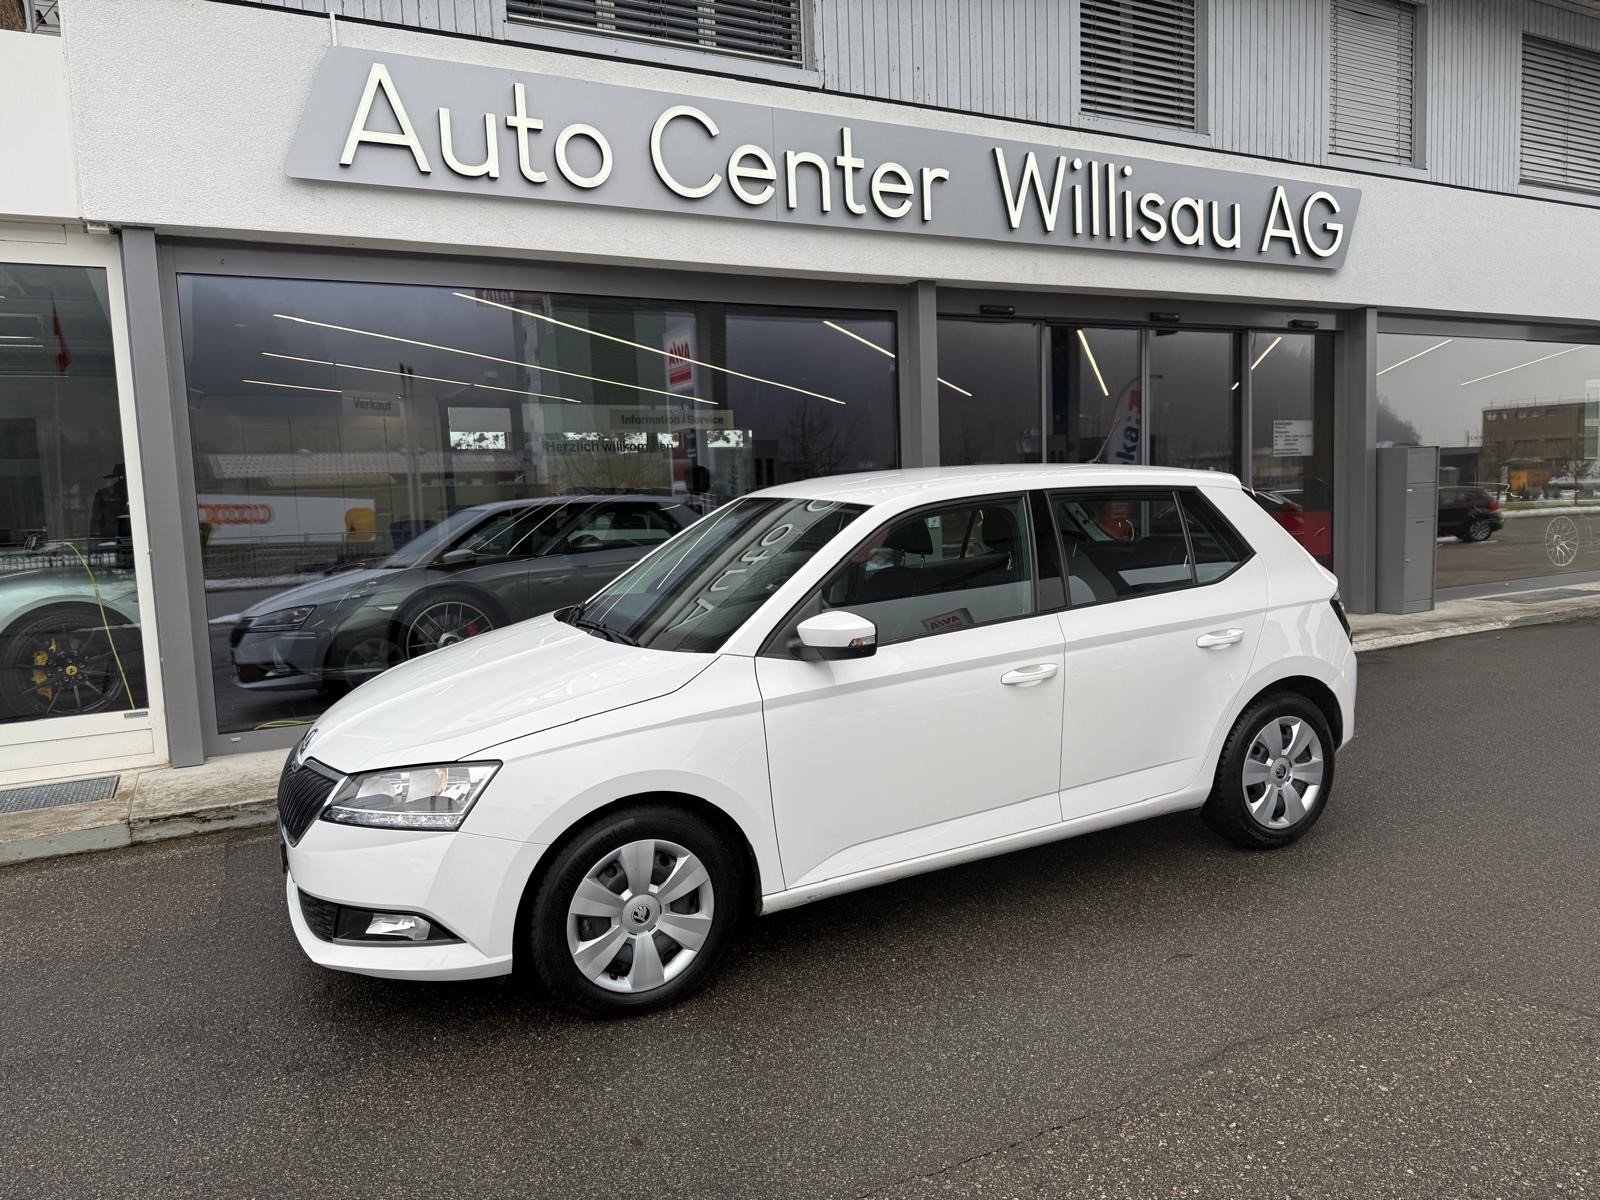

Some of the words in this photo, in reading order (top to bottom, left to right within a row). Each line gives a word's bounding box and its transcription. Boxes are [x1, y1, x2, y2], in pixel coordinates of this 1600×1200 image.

[338, 62, 613, 190] Auto
[648, 105, 949, 222] Center
[992, 147, 1241, 250] Willisau
[1260, 185, 1344, 259] AG
[353, 397, 392, 411] Verkauf
[621, 414, 681, 425] Information
[687, 414, 724, 425] Service
[546, 441, 599, 453] Herzlich
[602, 440, 674, 453] willkomen
